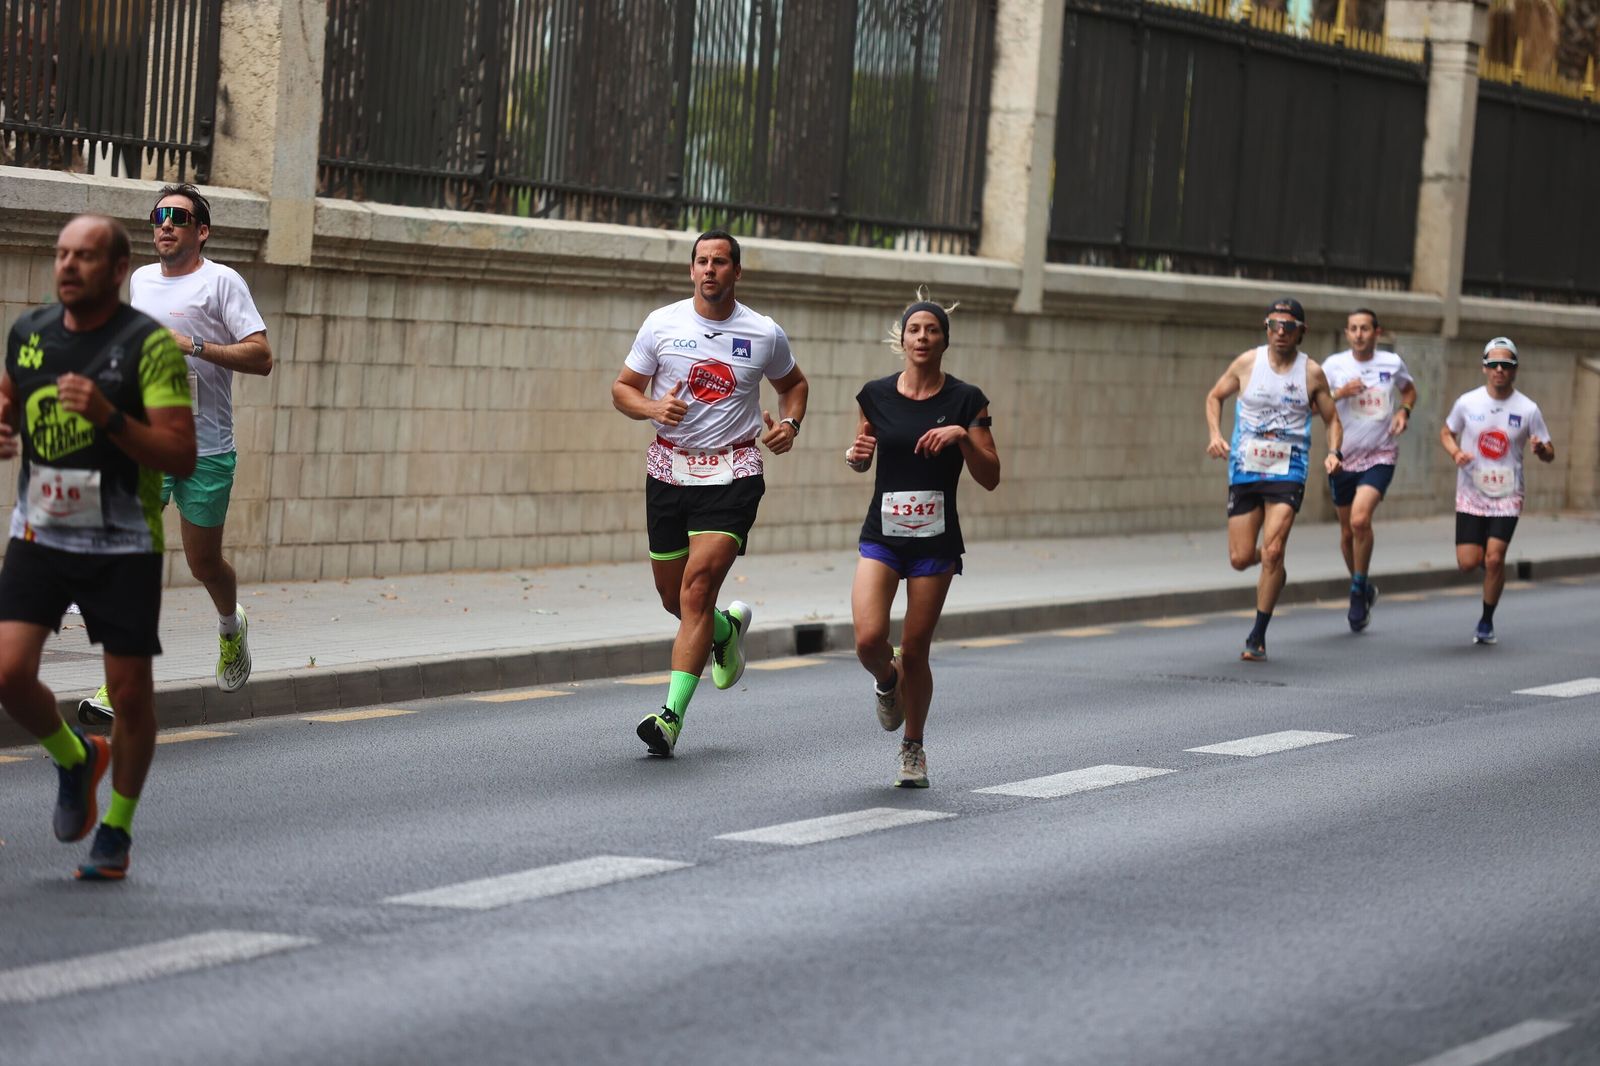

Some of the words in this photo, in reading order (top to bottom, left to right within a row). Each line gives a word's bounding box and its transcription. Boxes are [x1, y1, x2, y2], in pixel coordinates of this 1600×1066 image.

[694, 377, 727, 394] FRENO
[696, 368, 731, 388] PONLE
[687, 455, 719, 466] 338
[892, 503, 935, 516] 1347
